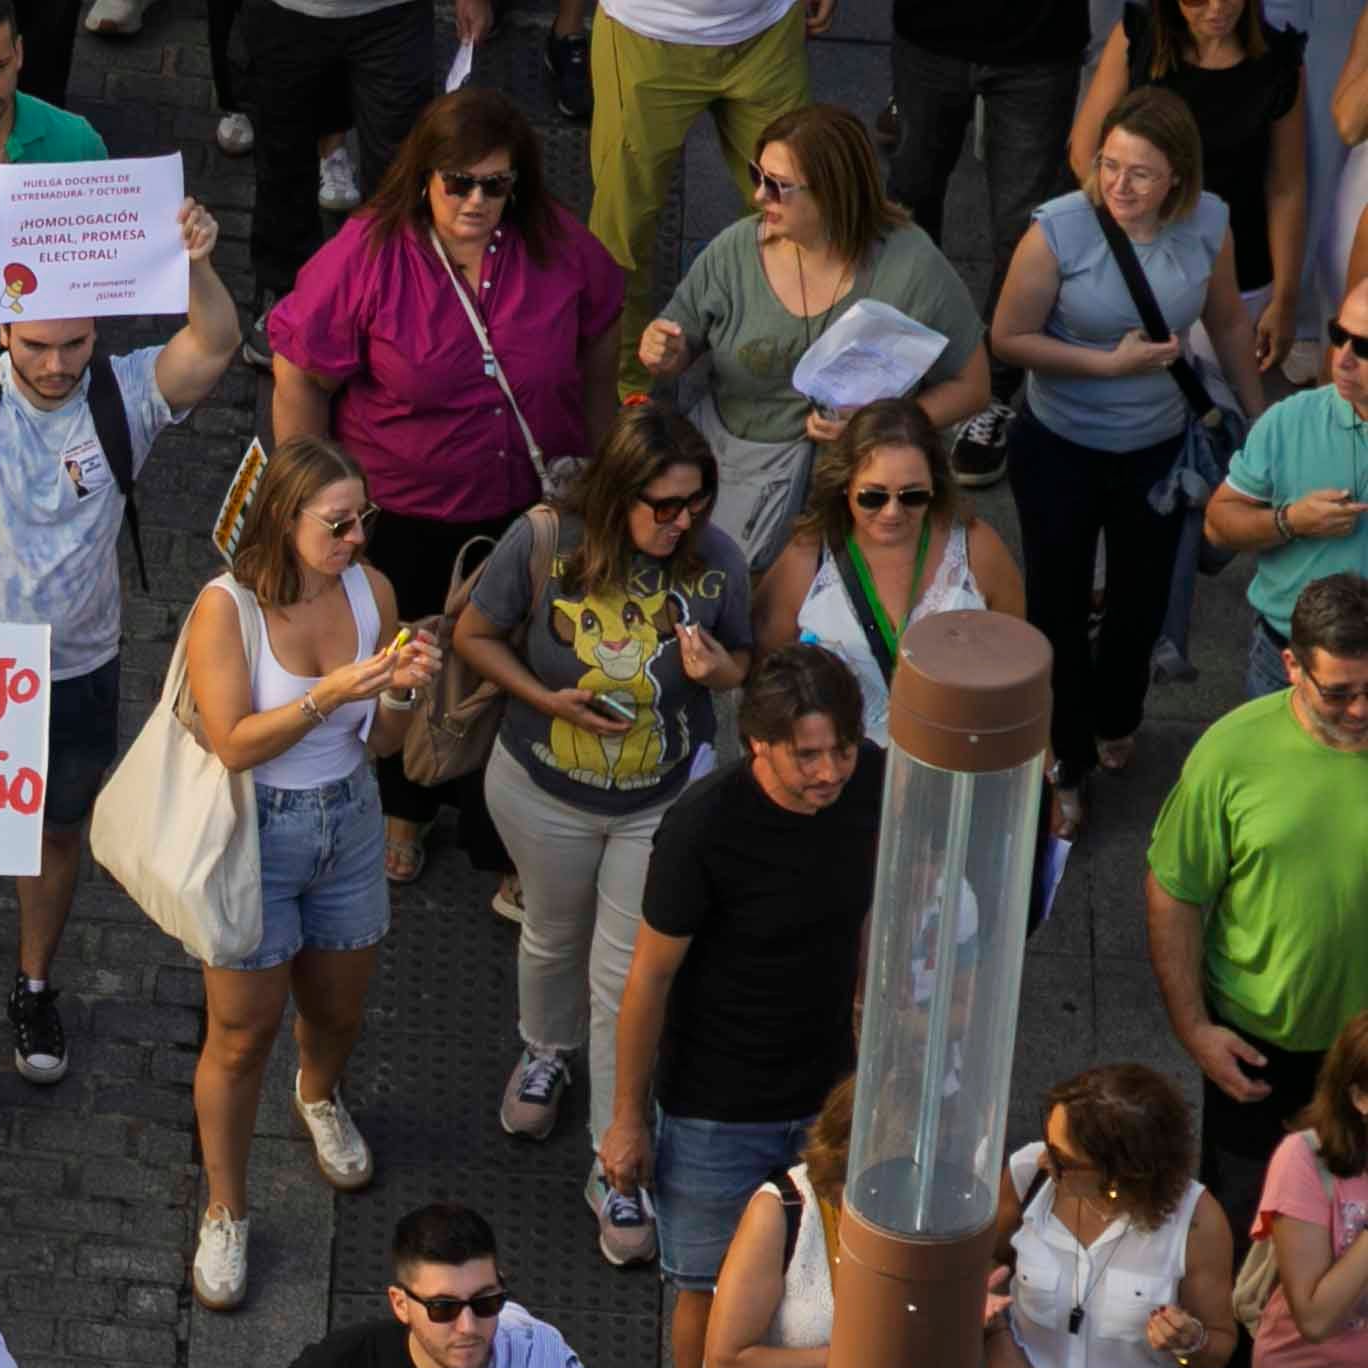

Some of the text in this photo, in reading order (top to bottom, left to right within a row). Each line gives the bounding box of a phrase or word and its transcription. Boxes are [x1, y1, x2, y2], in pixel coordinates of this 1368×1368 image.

[23, 174, 130, 189] HUELGA DOCENTES DE
[96, 186, 142, 197] OCTUBRE
[19, 210, 139, 232] ¡HOMOLOGACIÓN
[11, 229, 146, 248] SALARIAL, PROMESA
[39, 249, 118, 263] ELECTORAL!
